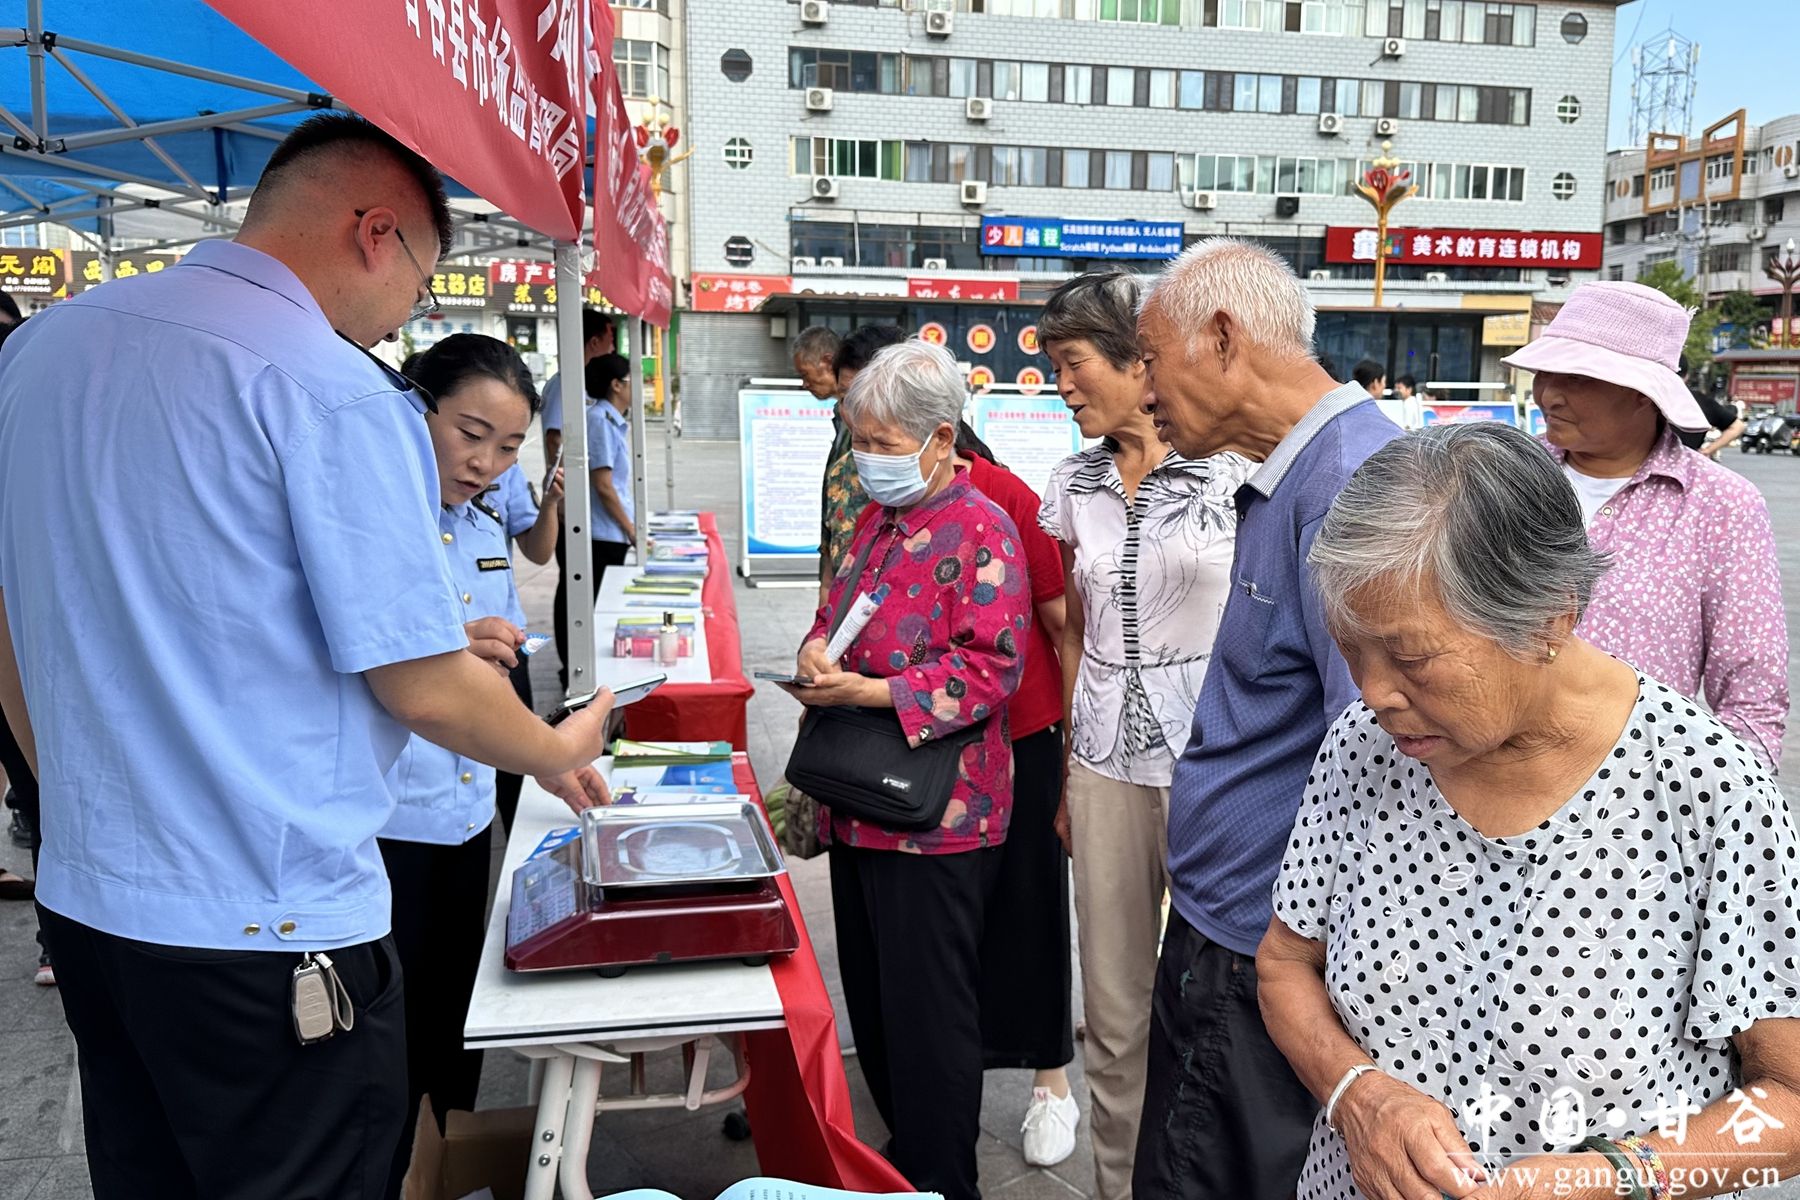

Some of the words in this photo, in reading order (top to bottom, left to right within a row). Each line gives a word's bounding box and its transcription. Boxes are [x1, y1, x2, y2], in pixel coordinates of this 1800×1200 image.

[987, 226, 1059, 247] 少儿编程
[1412, 235, 1581, 261] 美术教育连锁机构
